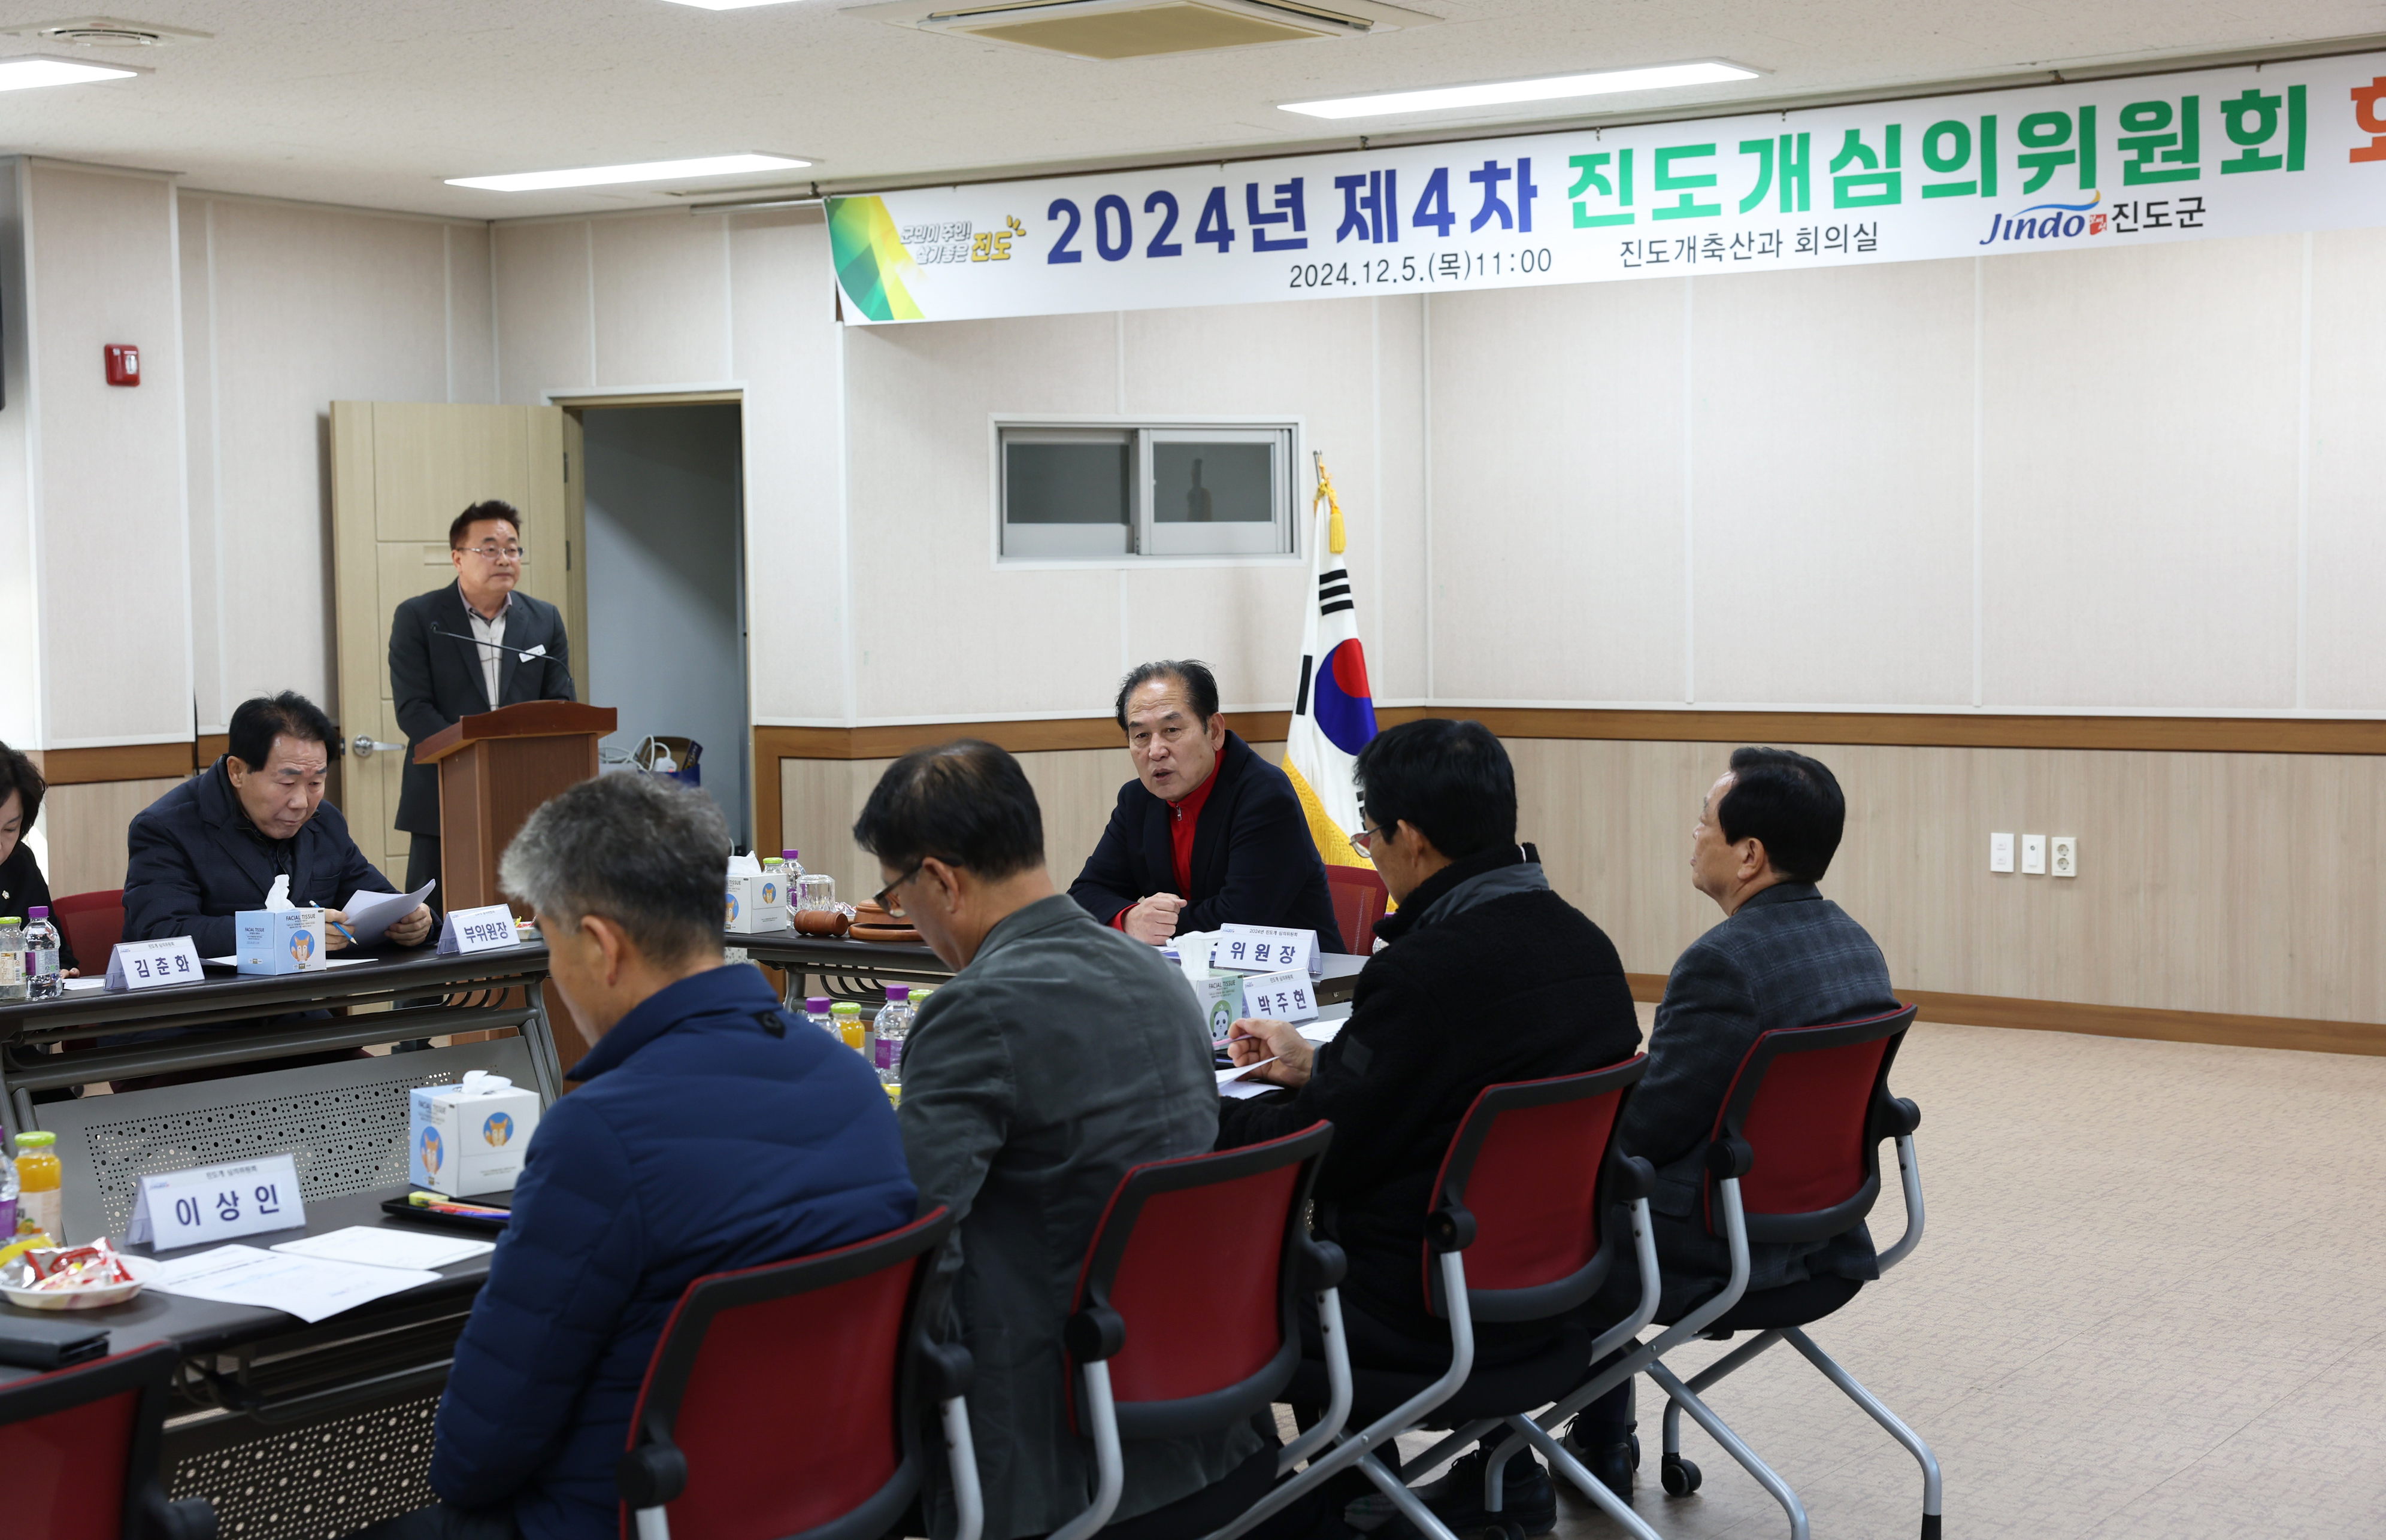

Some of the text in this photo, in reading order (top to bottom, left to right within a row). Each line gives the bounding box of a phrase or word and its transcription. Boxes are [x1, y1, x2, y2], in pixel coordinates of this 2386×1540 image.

[1047, 177, 1308, 265] 2024년
[1334, 157, 1538, 244] 제4차
[1567, 84, 2307, 229] 진도개심의위원회
[942, 221, 972, 241] 주인!
[1979, 211, 2085, 245] Jindo
[2112, 196, 2206, 234] 진도군
[971, 232, 1012, 262] 진도
[1619, 221, 1879, 268] 진도개축산과 회의실
[1289, 248, 1552, 288] 2024.12.5.(목)11:00
[464, 921, 508, 944] 부위원장
[134, 954, 190, 978] 김춘화
[1231, 941, 1295, 964] 위원장
[1258, 989, 1307, 1016] 박주현
[175, 1184, 280, 1226] 이상인
